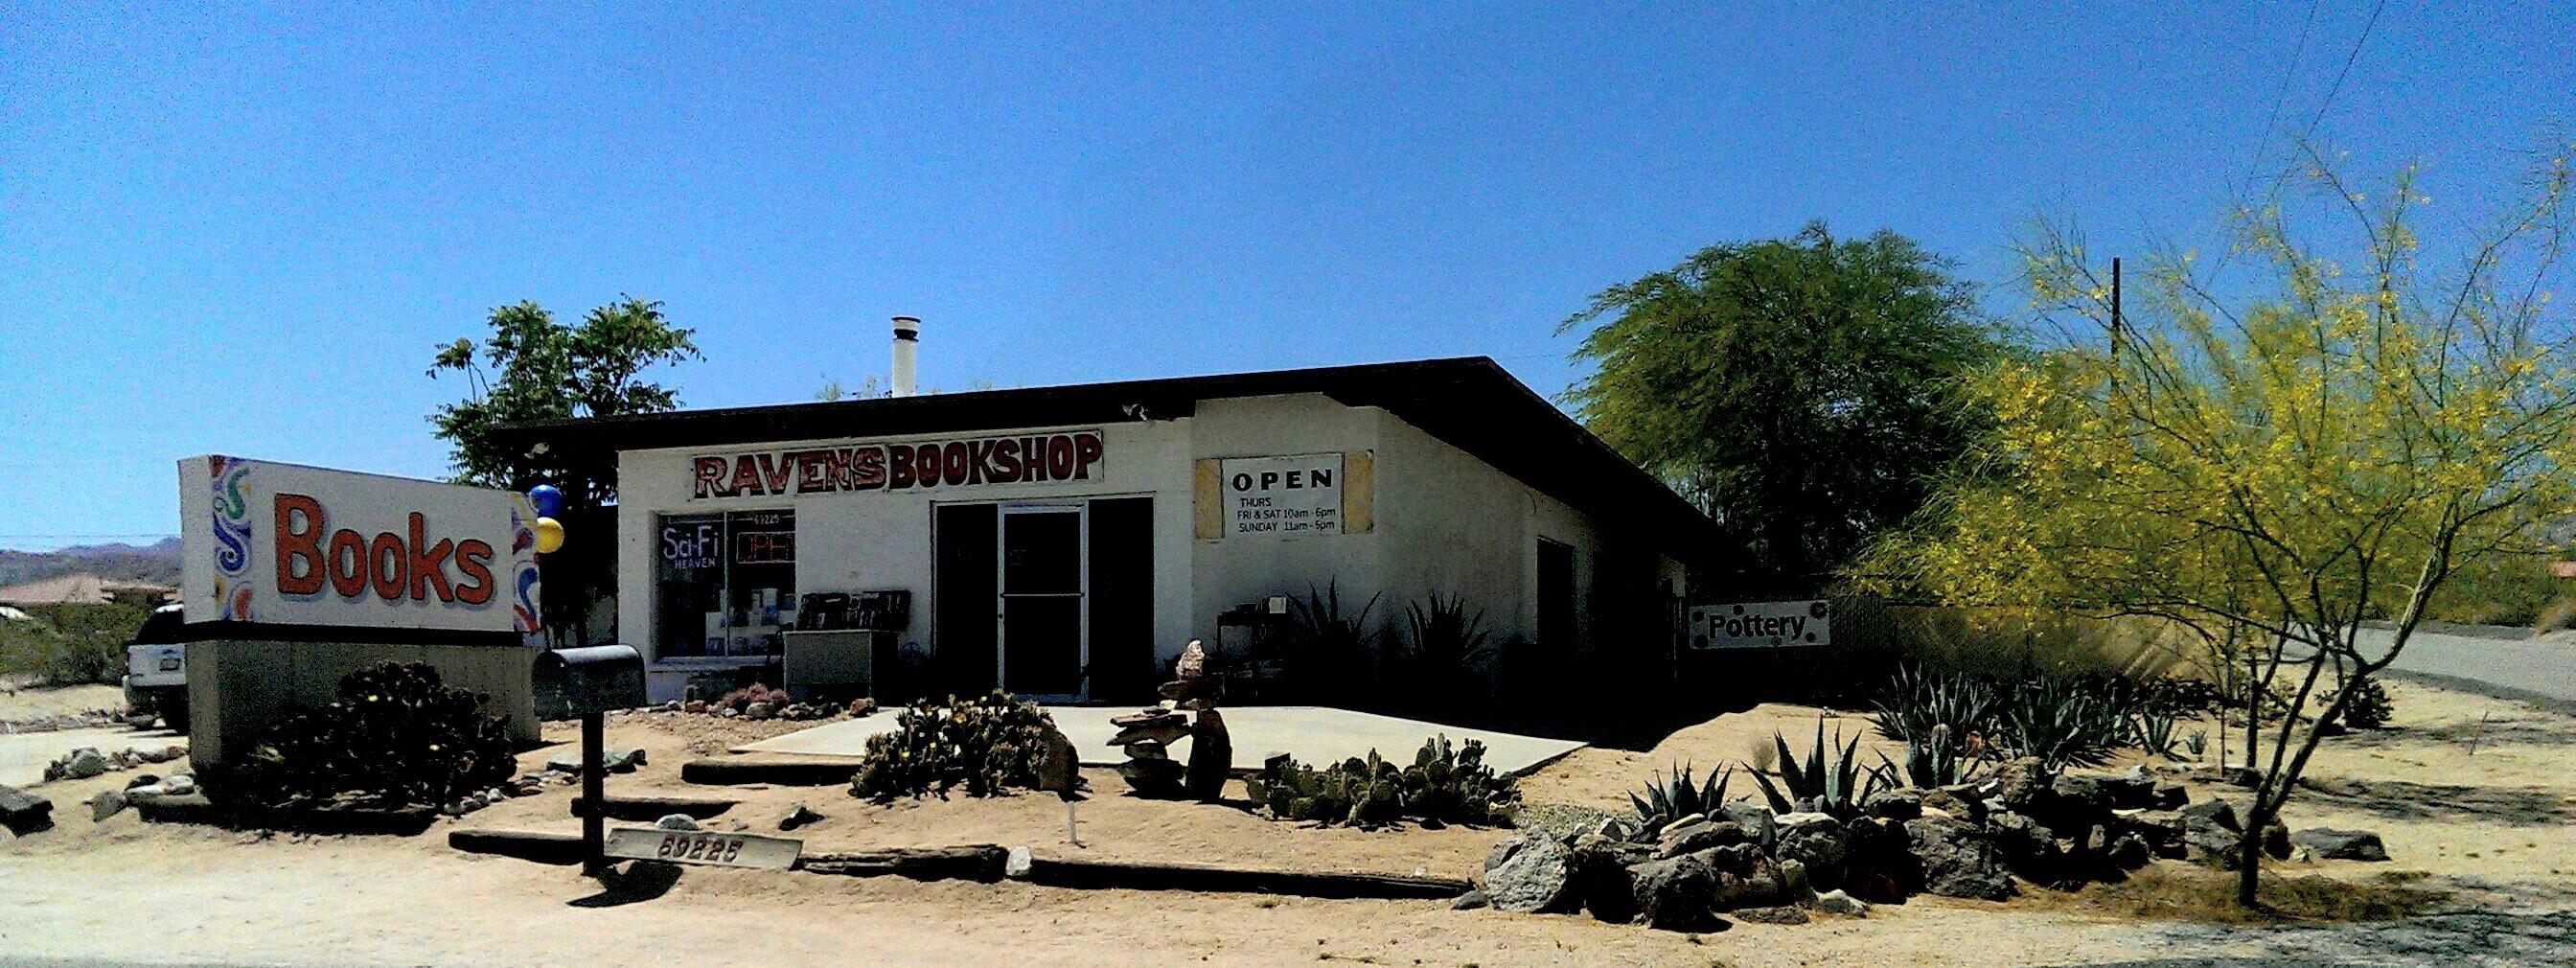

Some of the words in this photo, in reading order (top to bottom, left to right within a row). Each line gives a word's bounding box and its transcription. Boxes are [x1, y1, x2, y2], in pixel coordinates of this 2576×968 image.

[695, 447, 886, 498] RAVENS
[888, 433, 1102, 490] BOOKSHOP
[1232, 469, 1332, 492] OPEN
[1237, 510, 1252, 519] FRI
[1254, 510, 1261, 519] &
[1263, 509, 1281, 519] SAT
[1284, 508, 1308, 519] 10am
[1316, 507, 1336, 519] 6pm
[1240, 497, 1272, 507] THURS
[1239, 522, 1277, 532] SUNDAY
[1284, 521, 1308, 531] 11am
[1315, 520, 1335, 531] 5pm
[274, 493, 494, 605] Books
[674, 558, 716, 569] HEAVEN
[1709, 613, 1807, 641] Pottery
[658, 832, 744, 863] 69225
